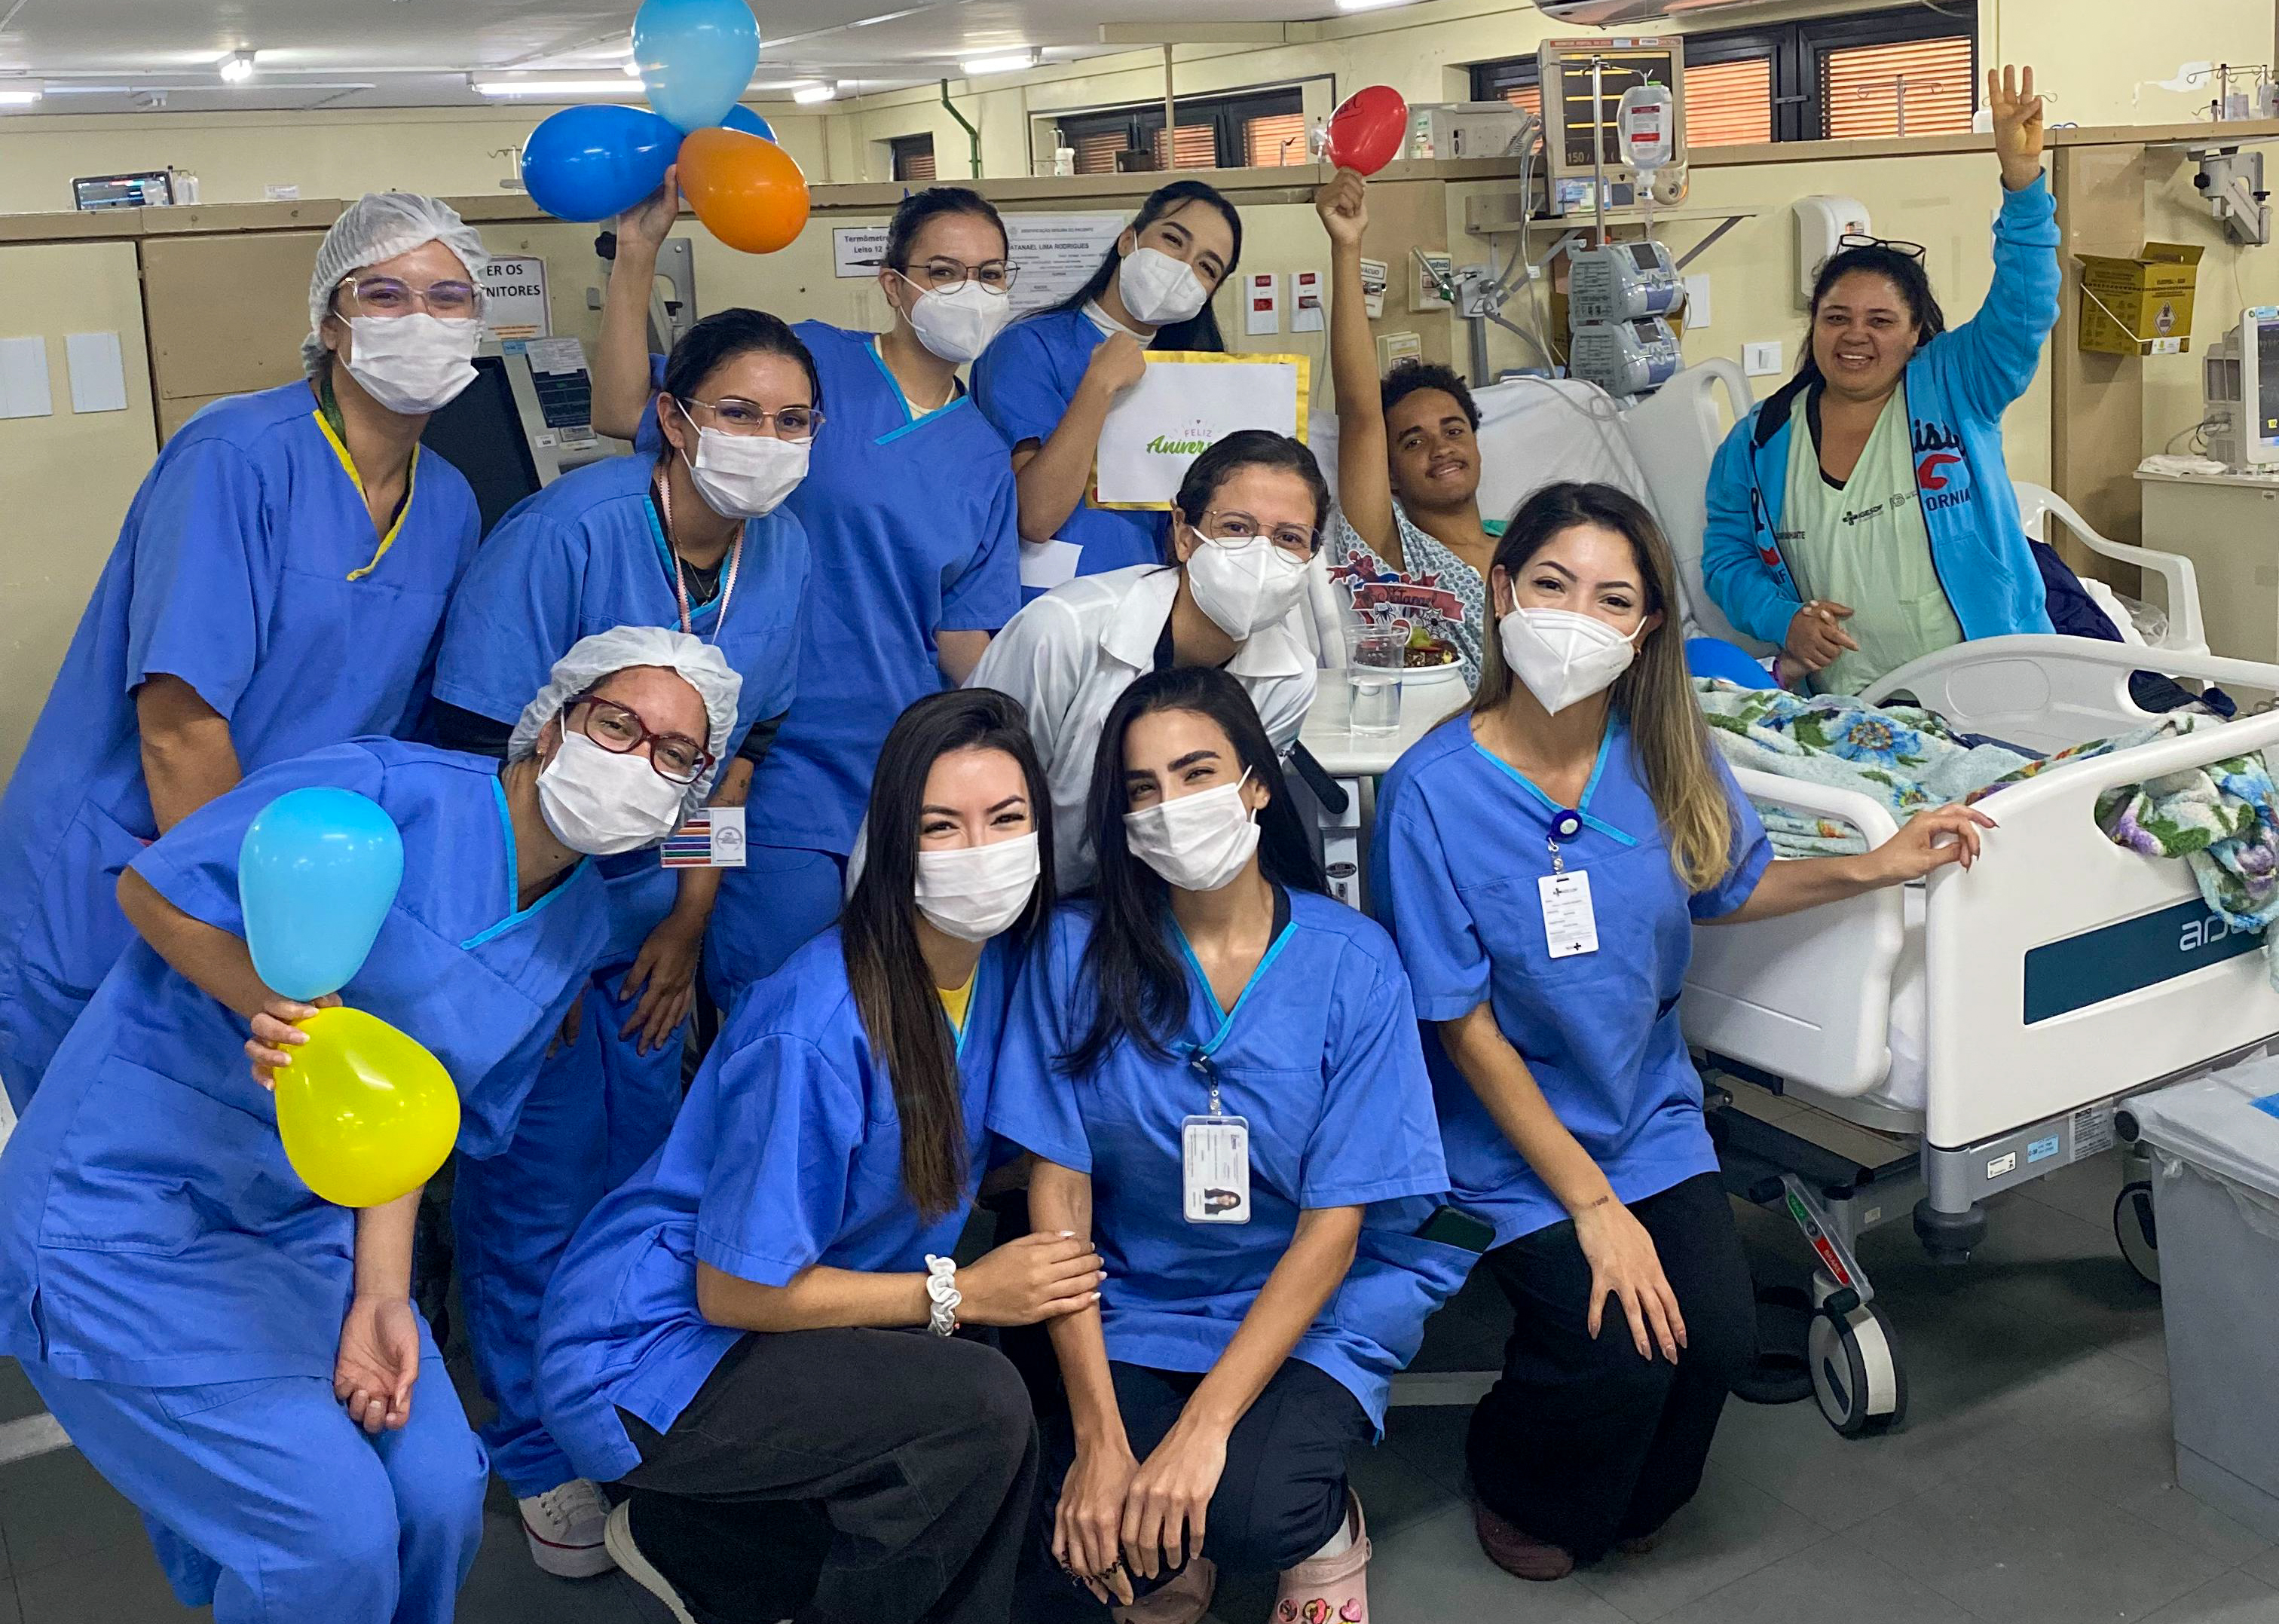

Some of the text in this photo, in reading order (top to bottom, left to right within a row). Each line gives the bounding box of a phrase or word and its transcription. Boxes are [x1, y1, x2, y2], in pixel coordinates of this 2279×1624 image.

[506, 264, 523, 275] OS
[486, 285, 541, 297] NITORES
[1184, 429, 1213, 437] FELIZ
[1926, 488, 1972, 512] ORNIA
